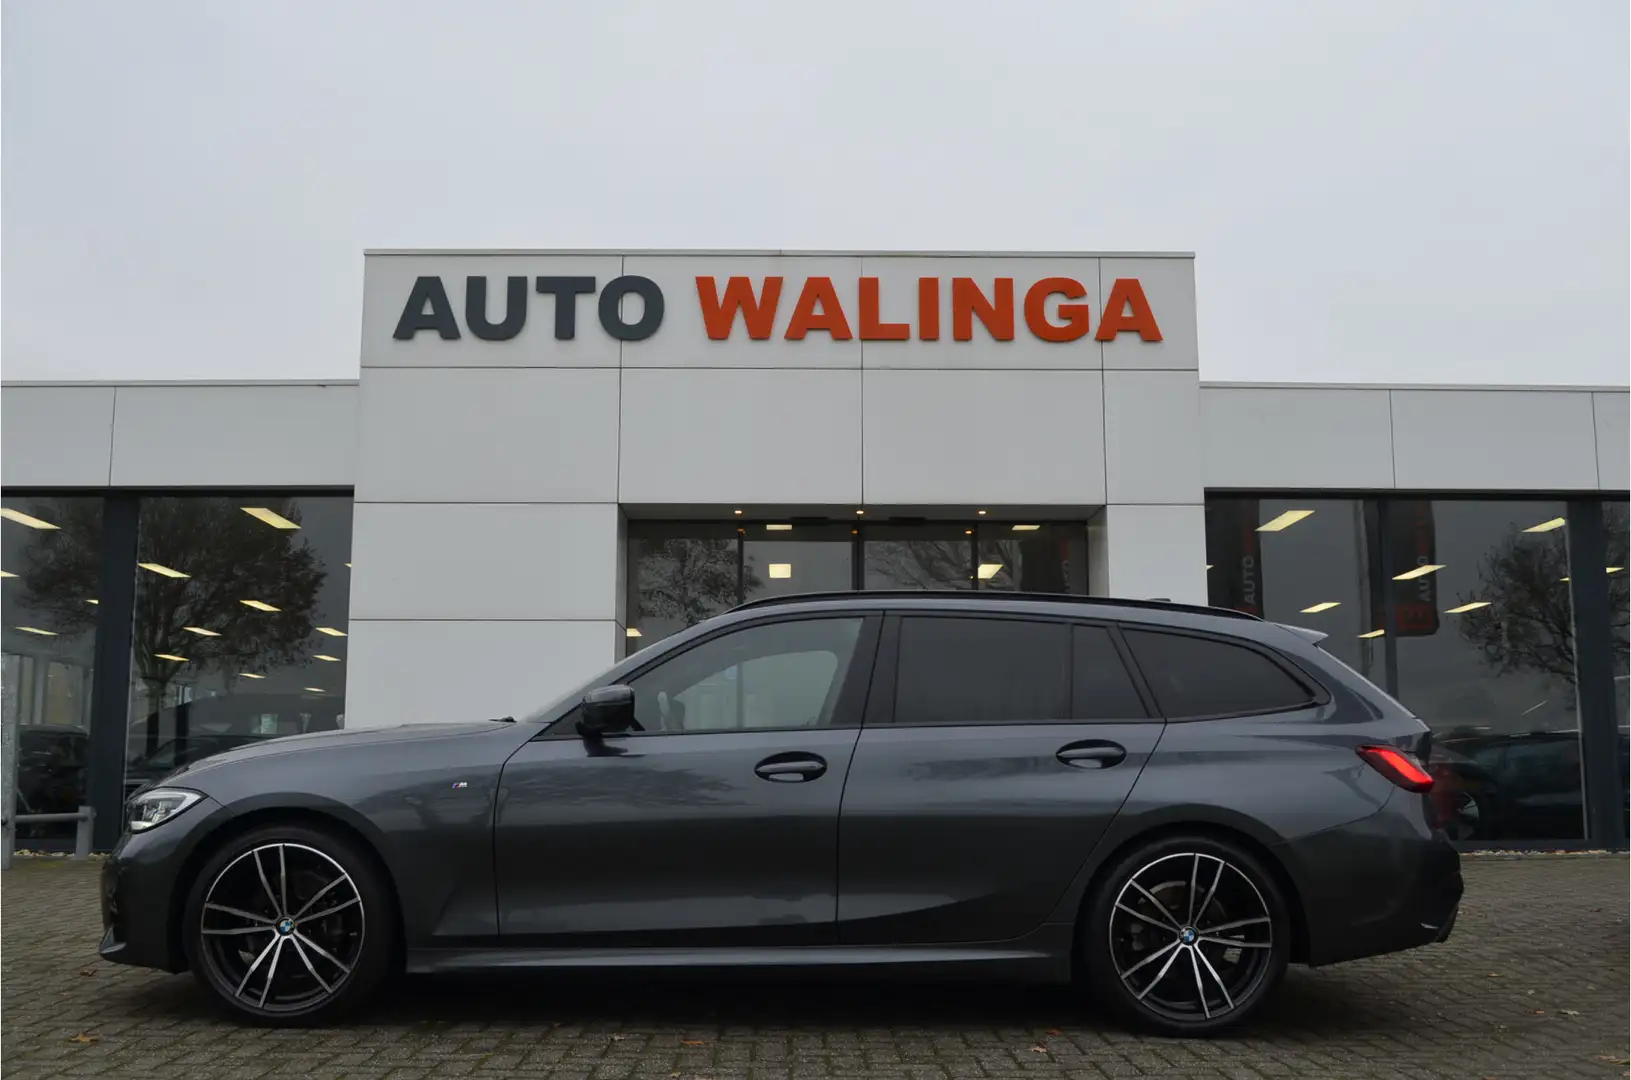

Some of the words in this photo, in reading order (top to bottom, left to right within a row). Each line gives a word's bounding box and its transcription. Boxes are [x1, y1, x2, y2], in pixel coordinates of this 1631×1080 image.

[393, 276, 665, 342] AUTO
[696, 276, 1163, 343] WALINGA
[1242, 556, 1256, 604] AUTO
[1417, 555, 1431, 602] AUO
